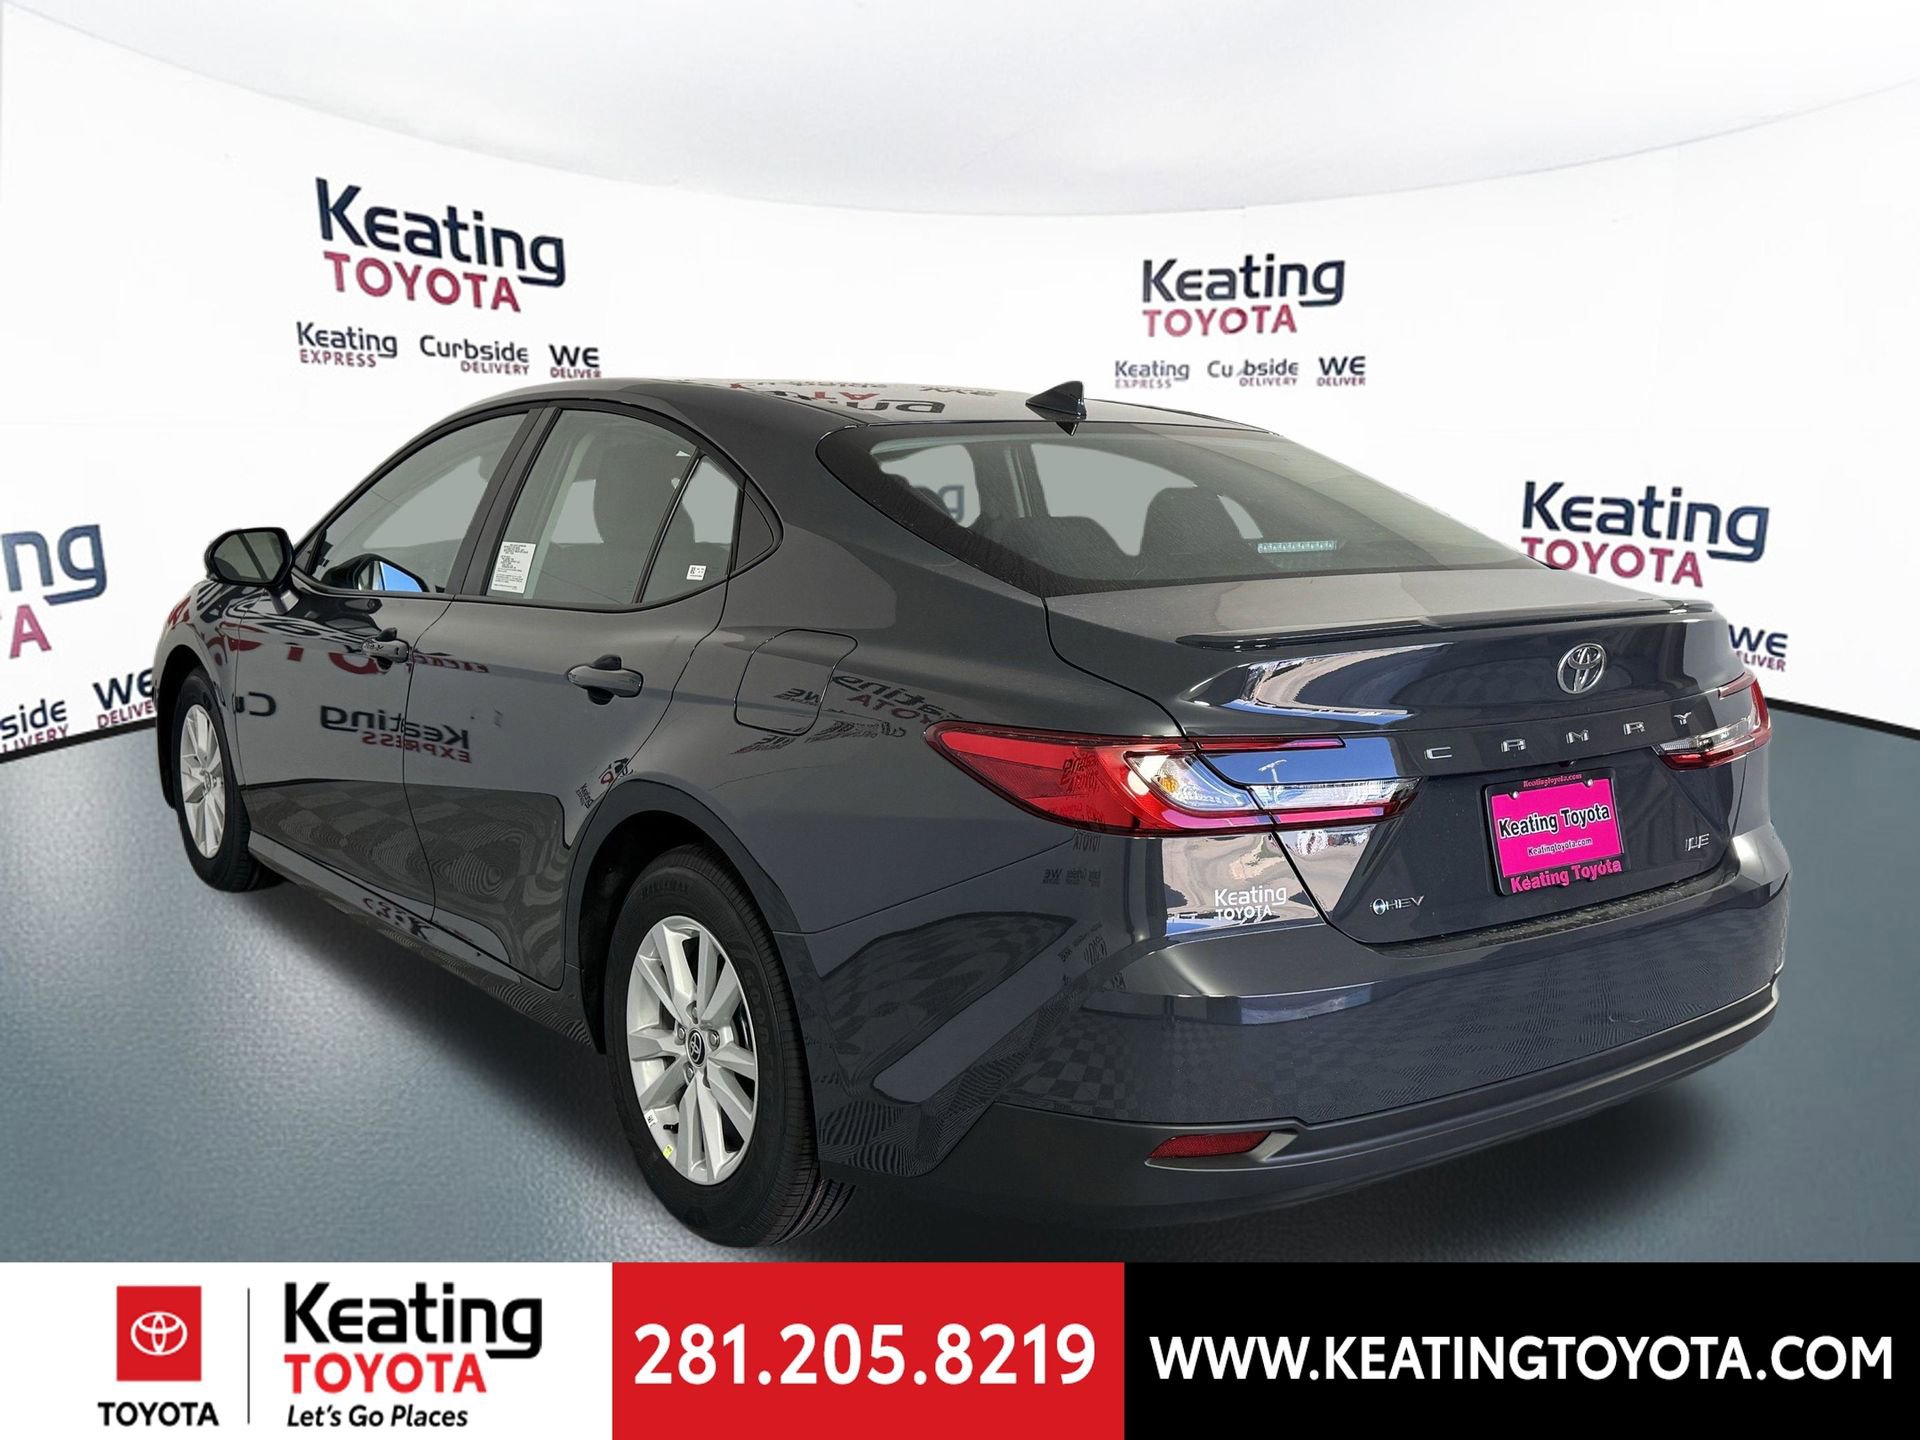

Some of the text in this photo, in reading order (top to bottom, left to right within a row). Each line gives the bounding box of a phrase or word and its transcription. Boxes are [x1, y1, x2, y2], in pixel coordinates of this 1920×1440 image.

[316, 177, 566, 287] Keating
[323, 250, 521, 313] TOYOTA
[1142, 253, 1345, 308] Keating
[1142, 304, 1297, 337] TOYOTA
[296, 321, 398, 358] Keating
[420, 334, 529, 363] Curbside
[299, 349, 377, 369] EXPRESS
[460, 360, 530, 375] DELIVERY
[549, 344, 600, 367] WE
[1207, 359, 1299, 378] Cubside
[1319, 356, 1366, 376] WE
[1115, 360, 1190, 381] Keating
[1115, 378, 1172, 389] EXPRESS
[1239, 377, 1298, 387] DELIVERY
[1317, 376, 1366, 387] DELIVER
[1522, 481, 1770, 563] Keating
[1521, 537, 1703, 587] TOYOTA
[1728, 624, 1788, 658] WE
[1735, 650, 1786, 672] LIVER
[97, 700, 154, 729] DELIVE
[1424, 711, 1692, 761] CAMRY
[1499, 804, 1610, 838] Keating Toyota
[1510, 859, 1622, 893] Keating Toyota
[1214, 885, 1287, 907] Keating
[1386, 895, 1425, 910] HEV
[1215, 905, 1273, 920] TOYOTA
